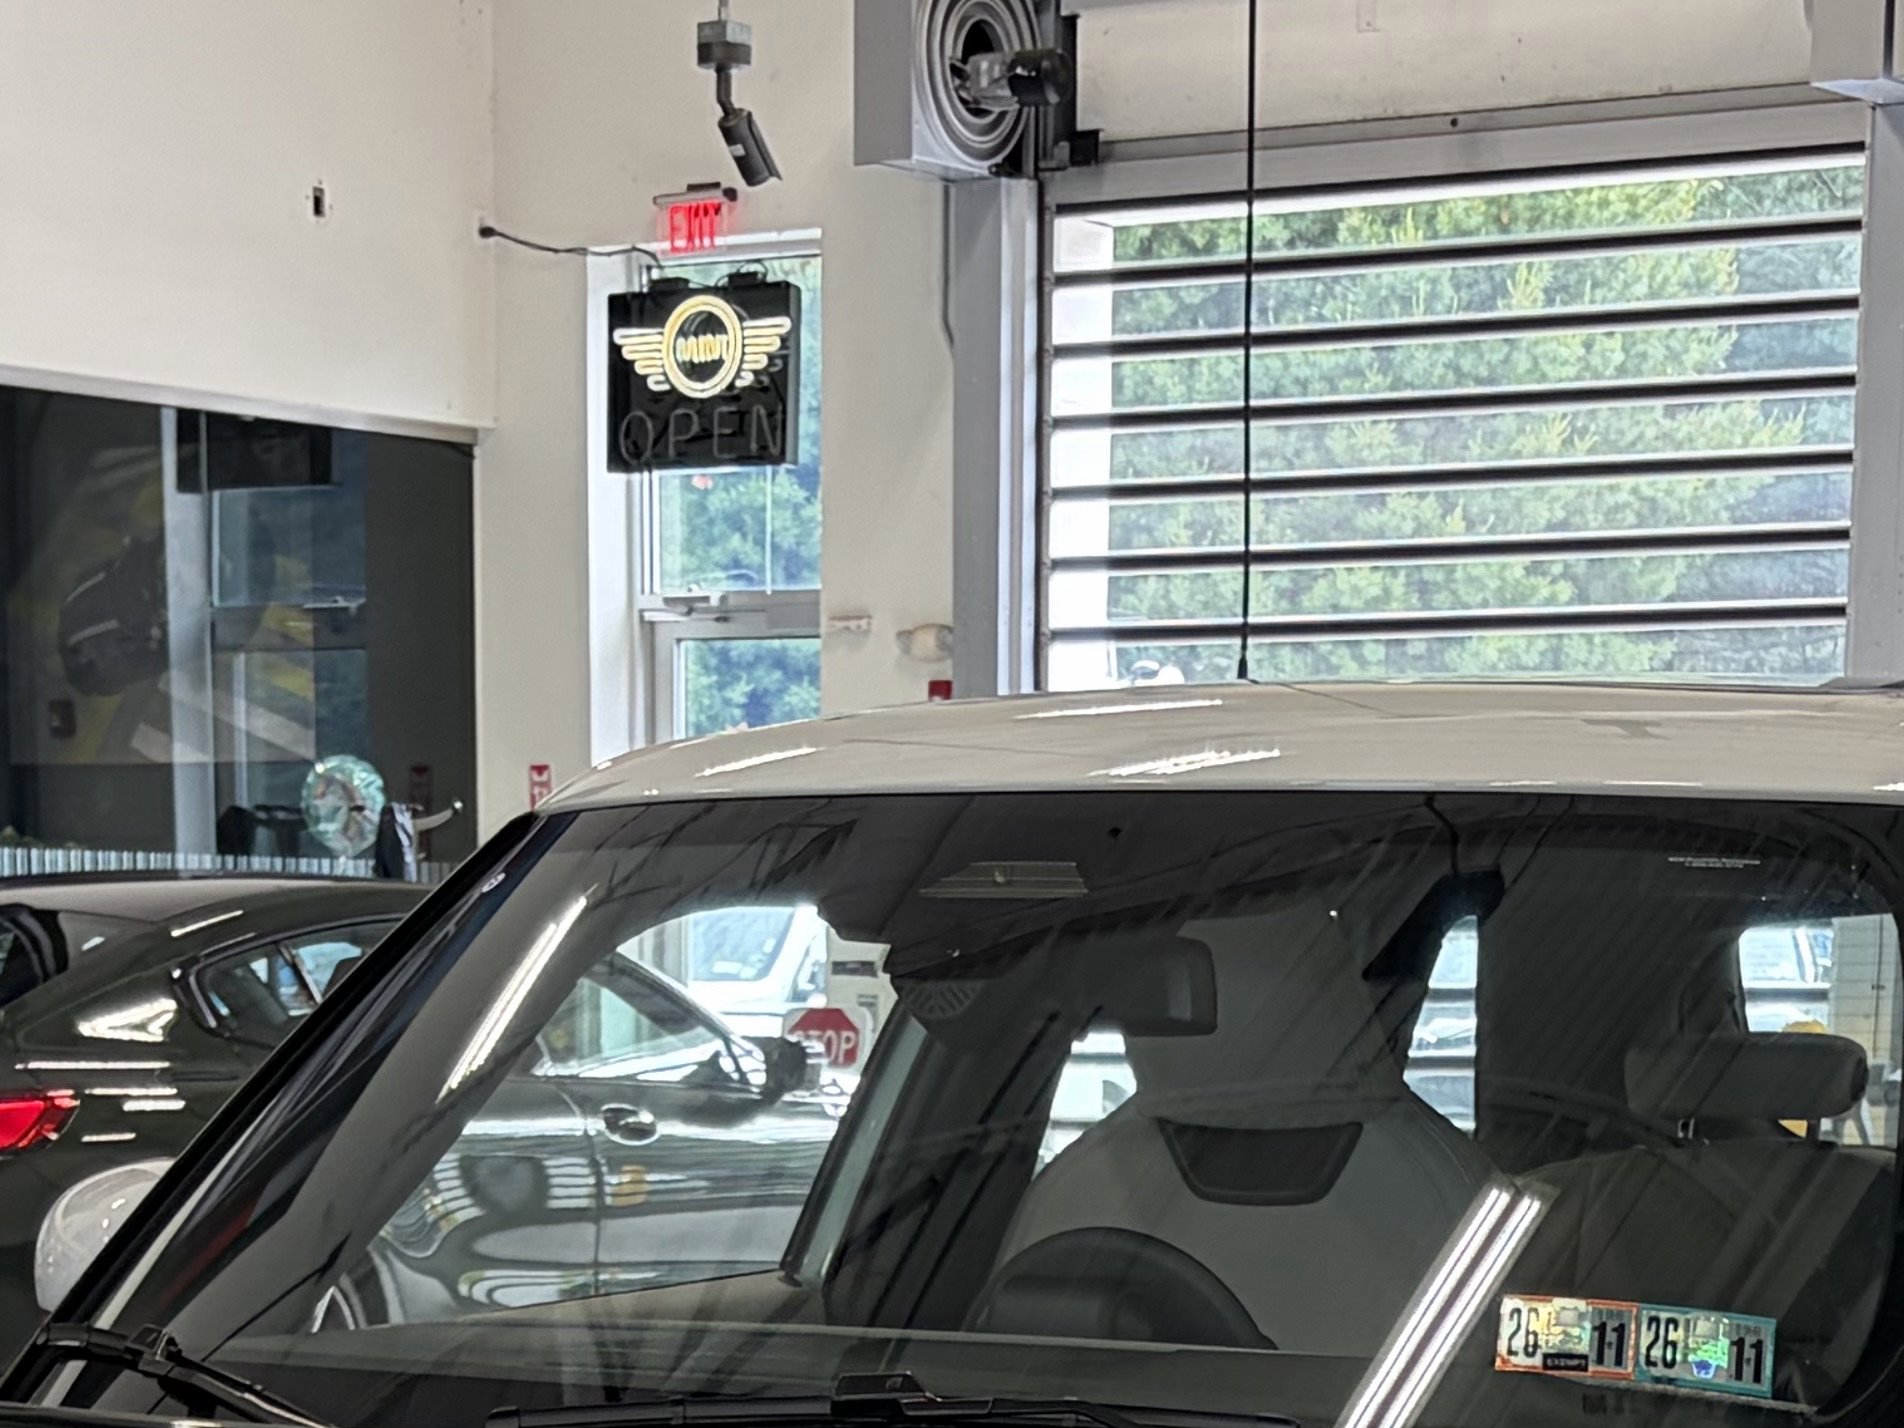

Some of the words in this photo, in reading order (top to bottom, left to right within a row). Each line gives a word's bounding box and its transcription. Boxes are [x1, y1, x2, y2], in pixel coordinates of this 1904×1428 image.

[669, 203, 721, 253] EXIT
[676, 334, 730, 364] MINI
[620, 404, 784, 466] OPEN
[1506, 1306, 1542, 1358] 26
[1592, 1320, 1626, 1367] 11
[1644, 1315, 1680, 1370] 26
[1730, 1335, 1764, 1384] 11
